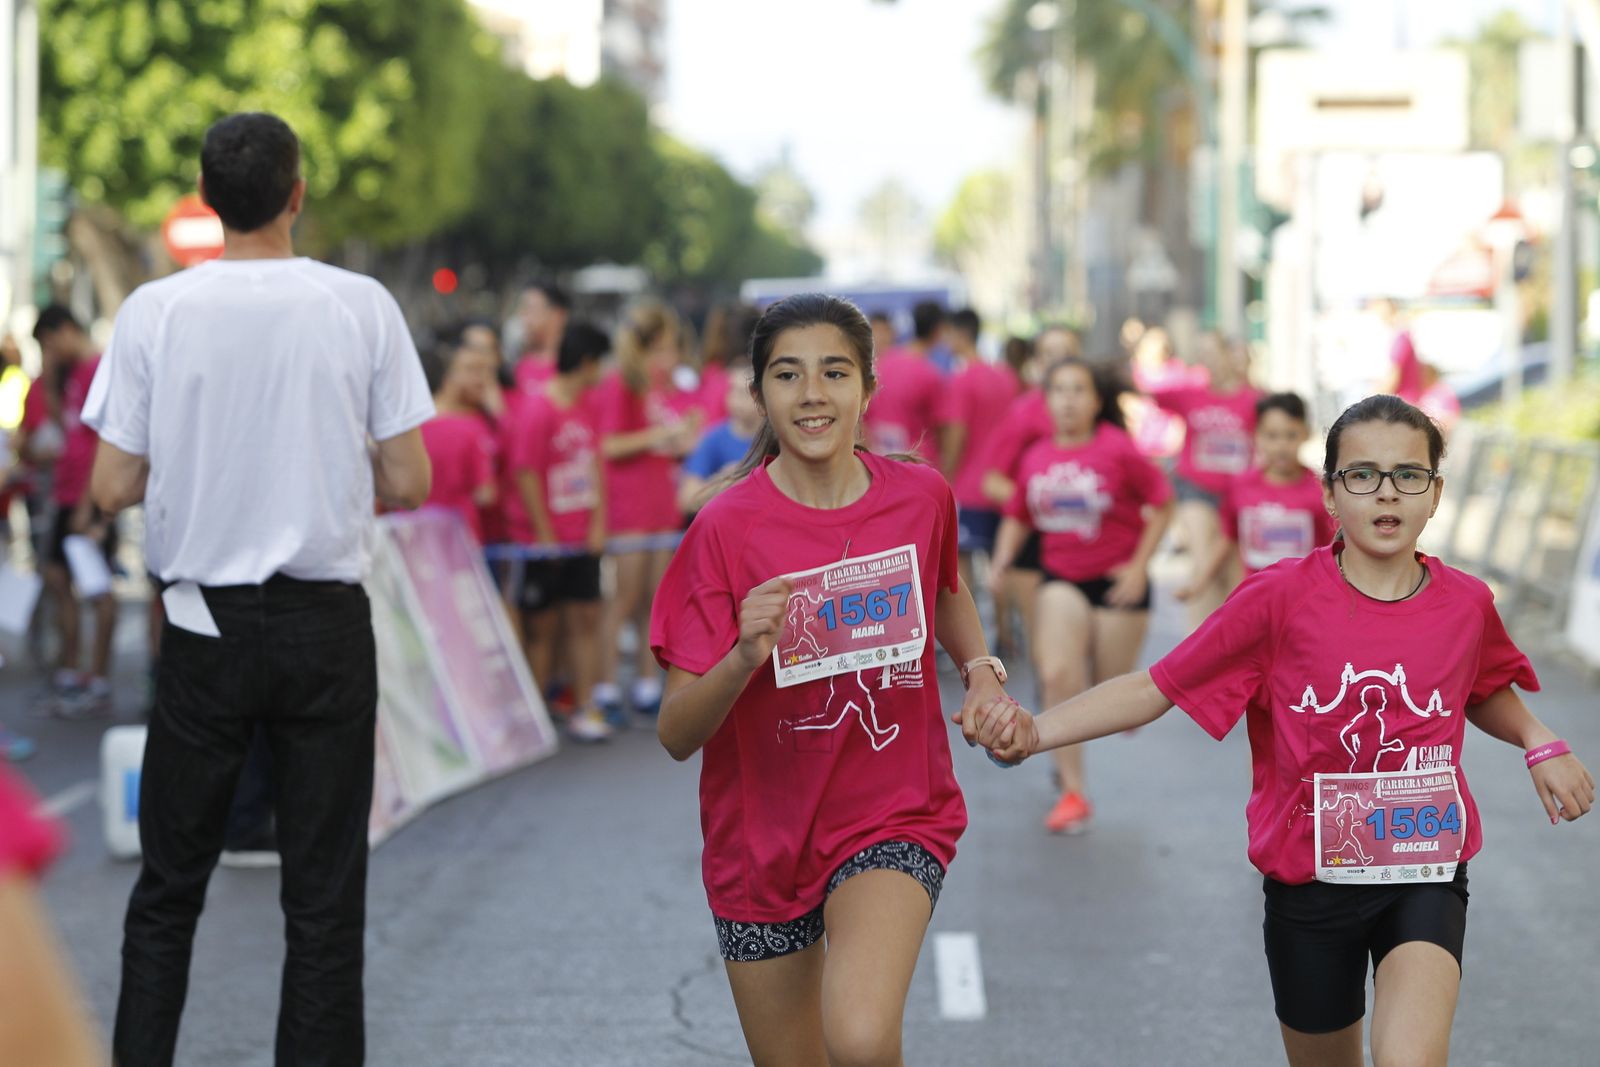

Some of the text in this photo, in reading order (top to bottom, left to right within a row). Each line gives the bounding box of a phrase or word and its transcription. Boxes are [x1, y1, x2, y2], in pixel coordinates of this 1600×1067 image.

[828, 563, 867, 580] CARRERA
[867, 553, 909, 573] SOLIDARIA
[817, 582, 912, 631] 1567
[851, 622, 885, 639] MARÍA
[1372, 778, 1383, 798] 4
[1381, 778, 1421, 790] CARRERA
[1366, 802, 1460, 840] 1564
[1392, 841, 1439, 853] GRACIELA
